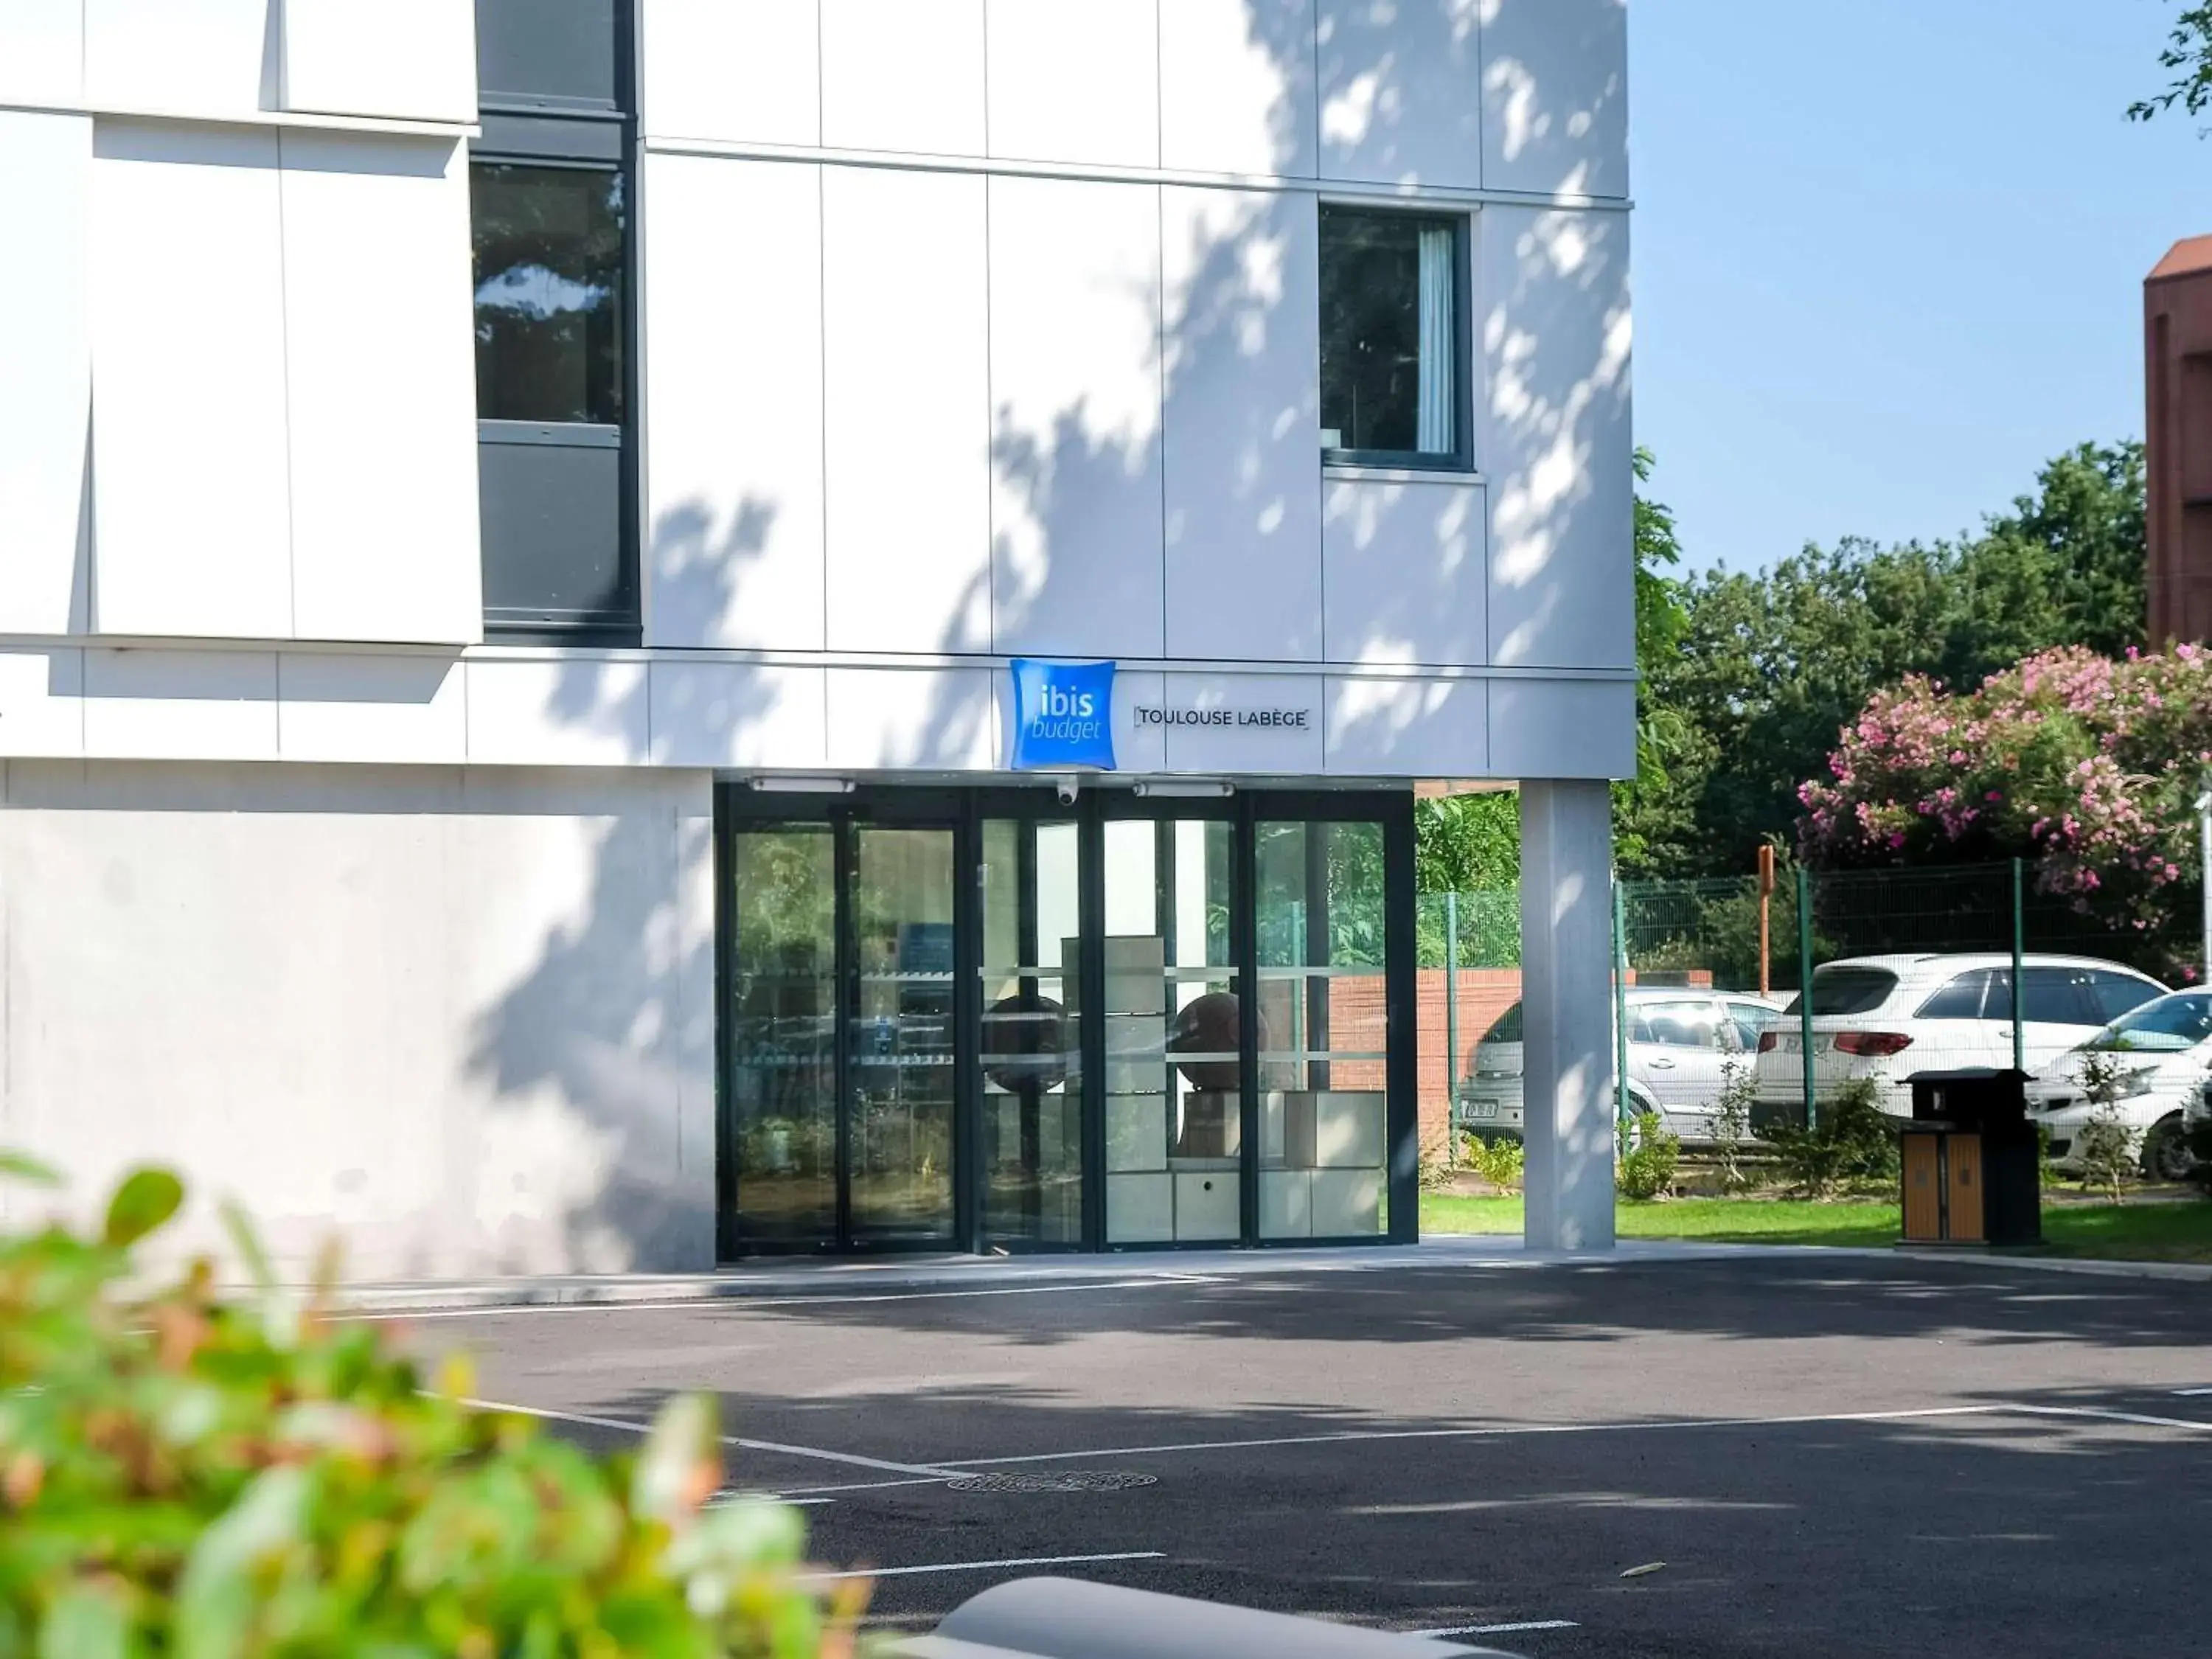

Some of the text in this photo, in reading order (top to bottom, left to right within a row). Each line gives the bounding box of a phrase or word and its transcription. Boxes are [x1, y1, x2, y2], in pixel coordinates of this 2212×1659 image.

[1041, 684, 1093, 717] ibis
[1032, 715, 1102, 744] budget
[1139, 709, 1306, 726] TOULOUSE LABÈGE
